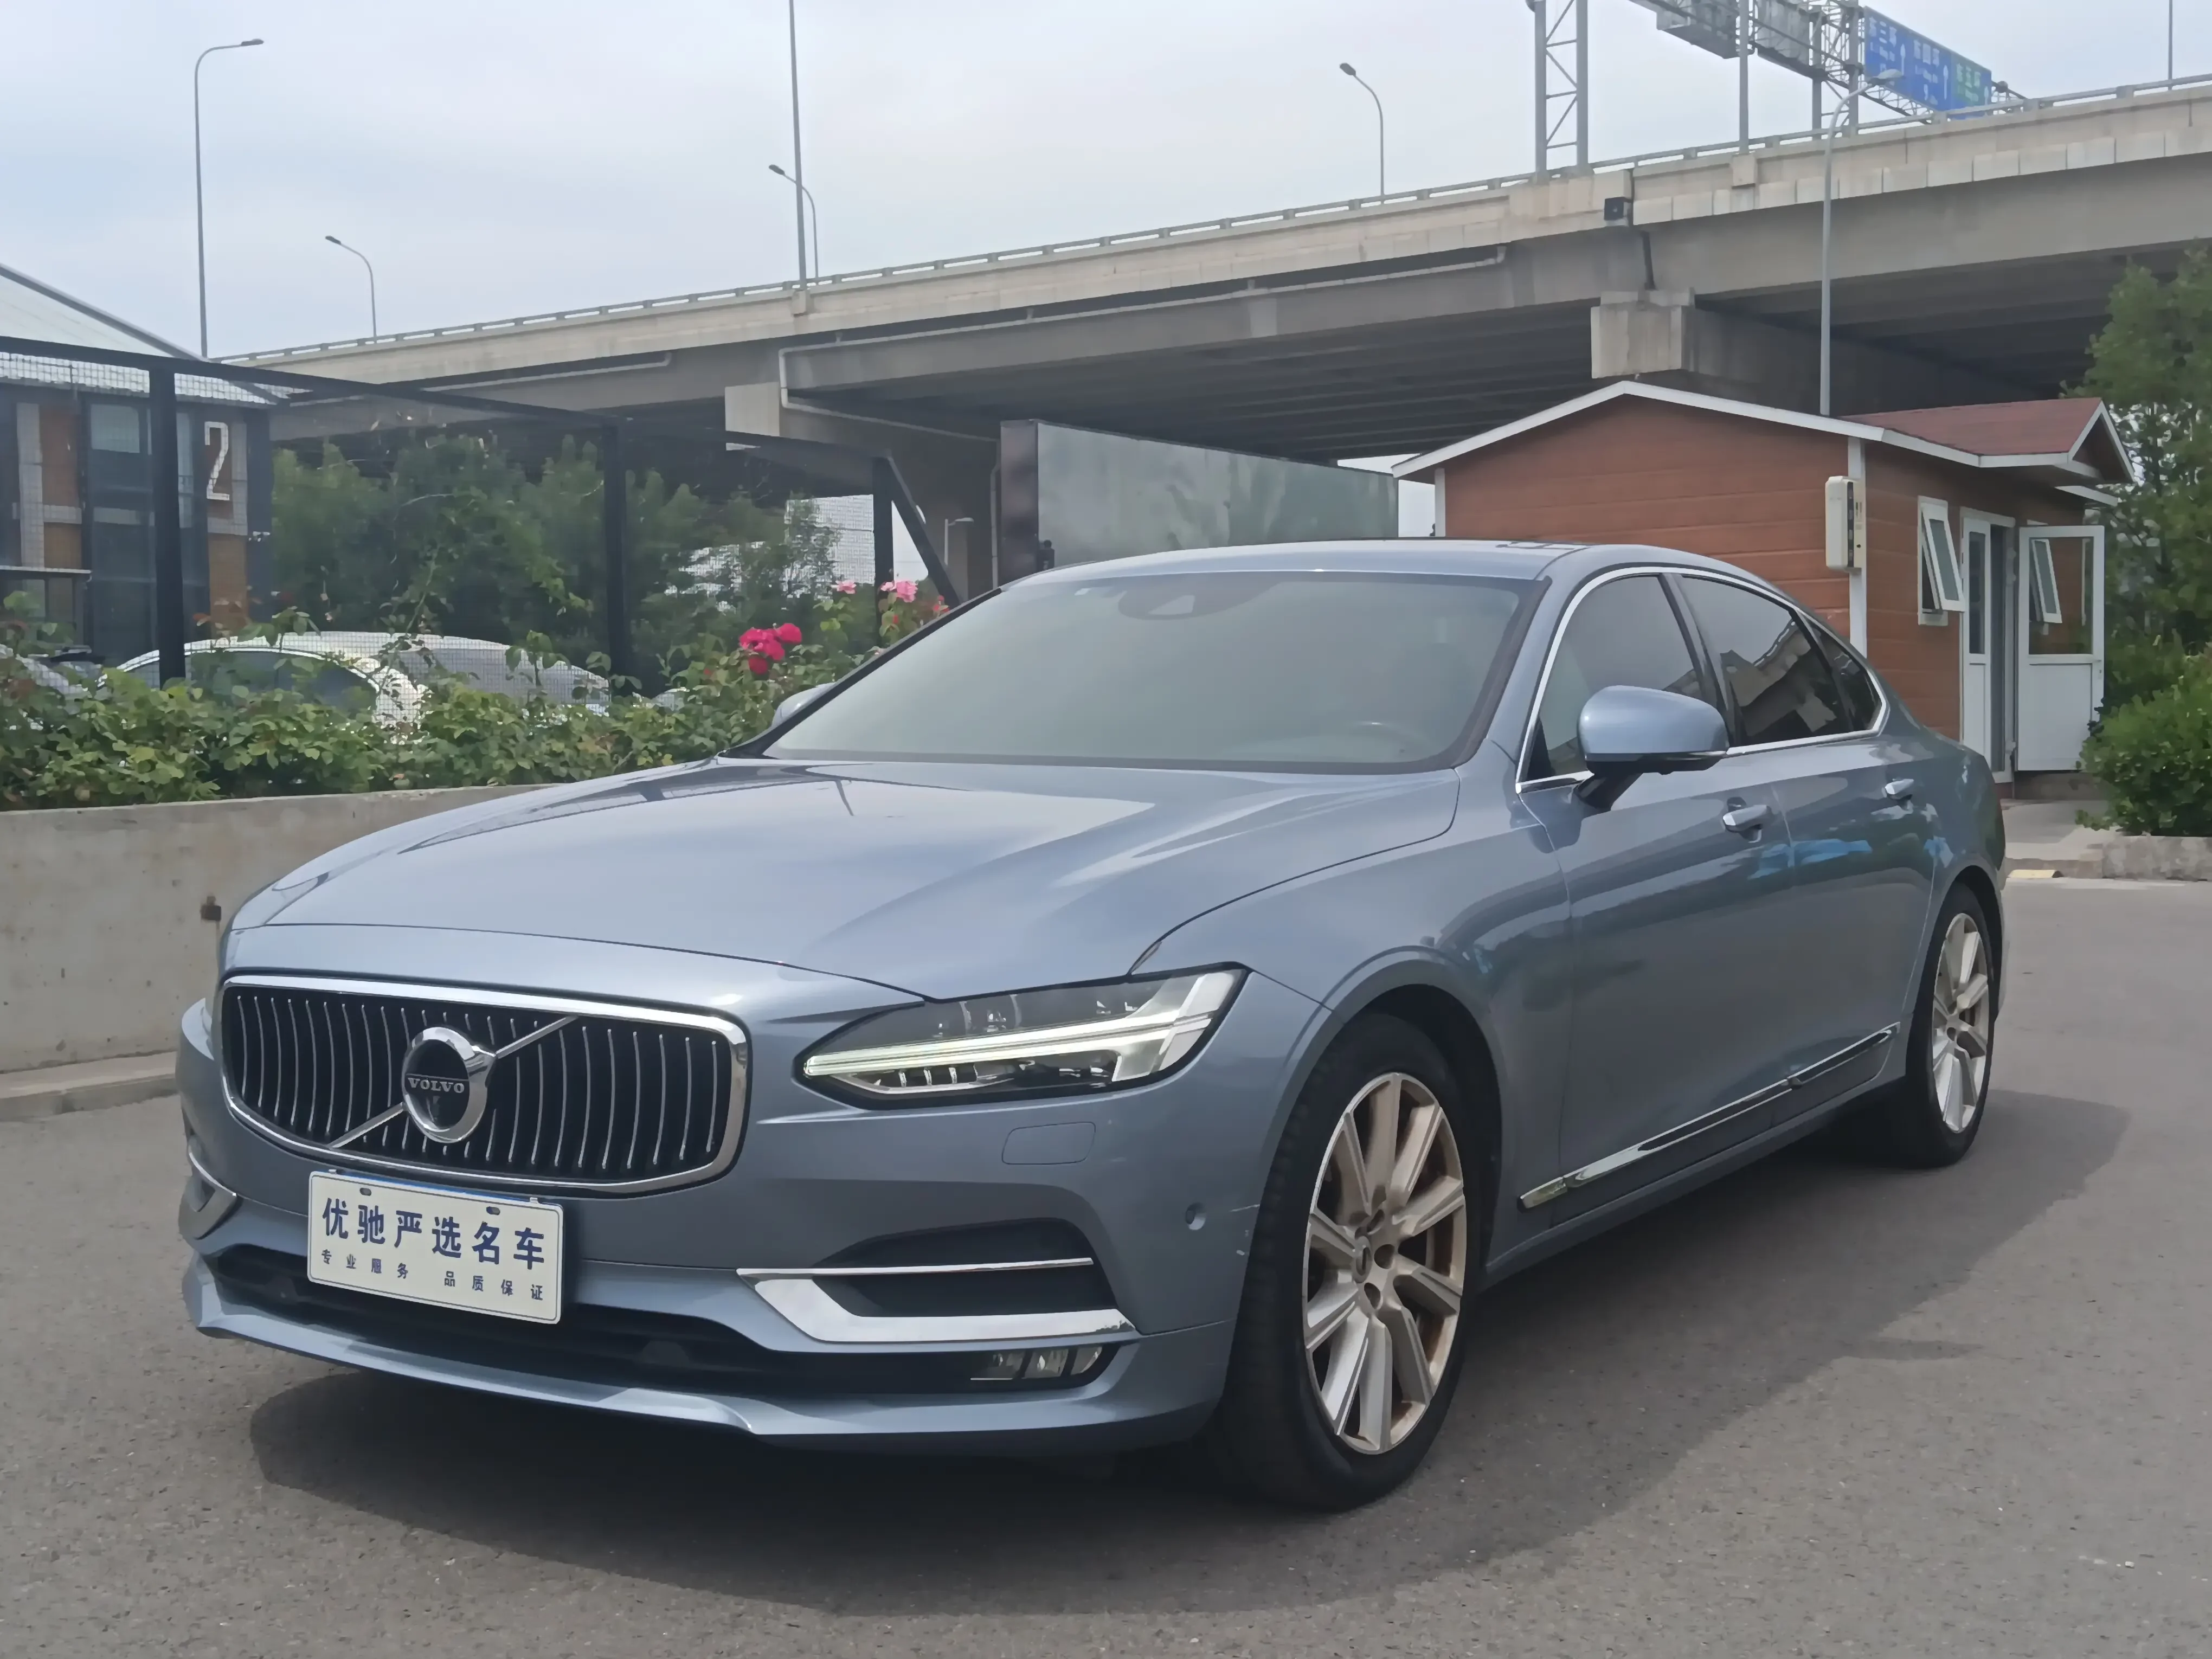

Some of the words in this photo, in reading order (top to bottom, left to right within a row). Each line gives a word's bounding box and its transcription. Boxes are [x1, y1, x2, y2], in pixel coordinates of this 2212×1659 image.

[204, 421, 230, 500] 2
[408, 1078, 465, 1093] VOLVO
[323, 1198, 544, 1270] 优驰严选名车
[321, 1249, 409, 1279] 专业服务
[444, 1271, 543, 1301] 品质保证
